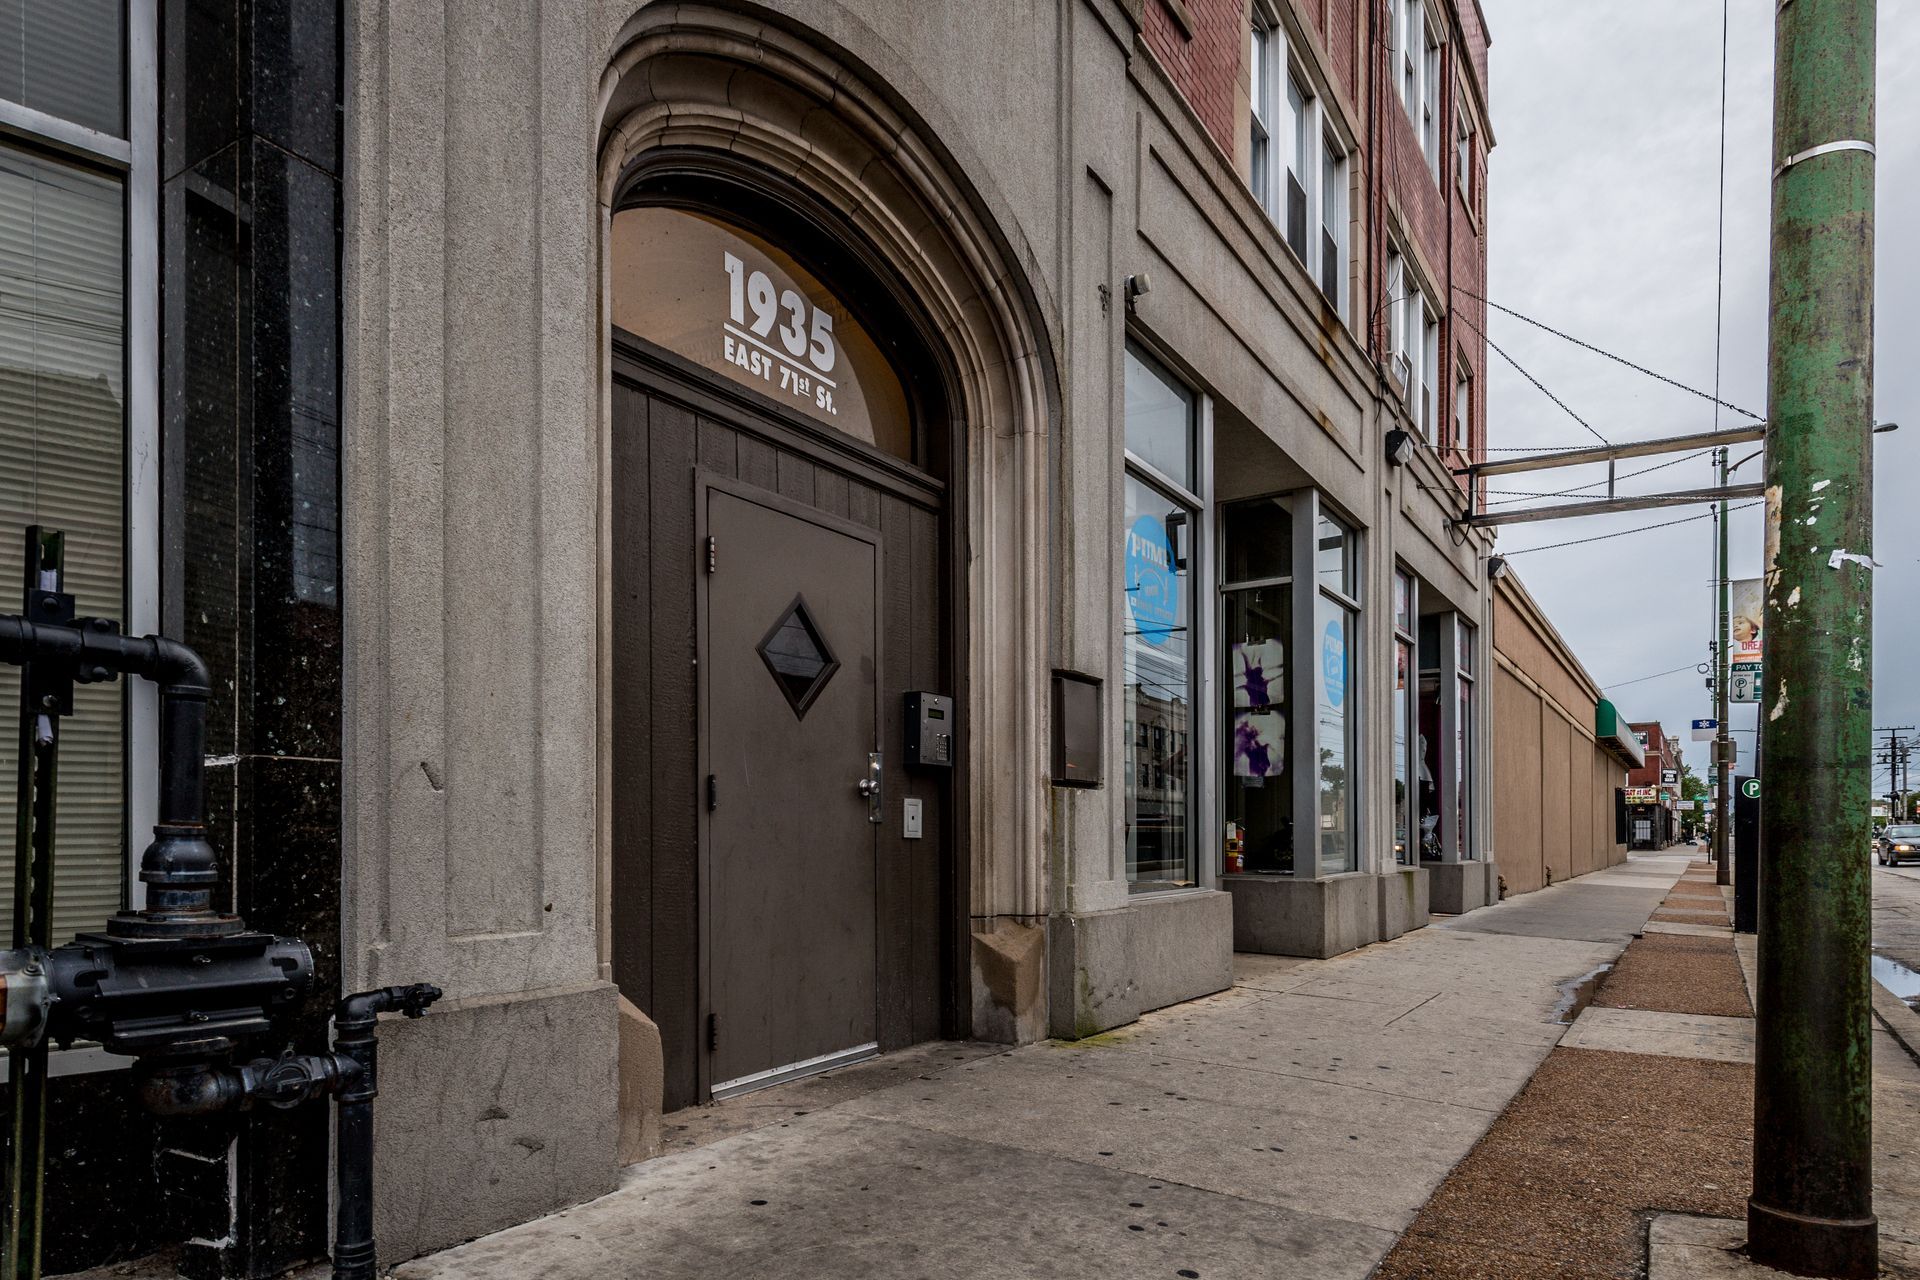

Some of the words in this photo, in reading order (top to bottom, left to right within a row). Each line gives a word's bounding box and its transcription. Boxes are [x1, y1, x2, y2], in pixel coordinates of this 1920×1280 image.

[724, 251, 835, 372] 1935
[724, 335, 772, 381] EAST
[779, 365, 811, 397] 71st
[815, 385, 837, 415] St.
[1749, 782, 1759, 796] P
